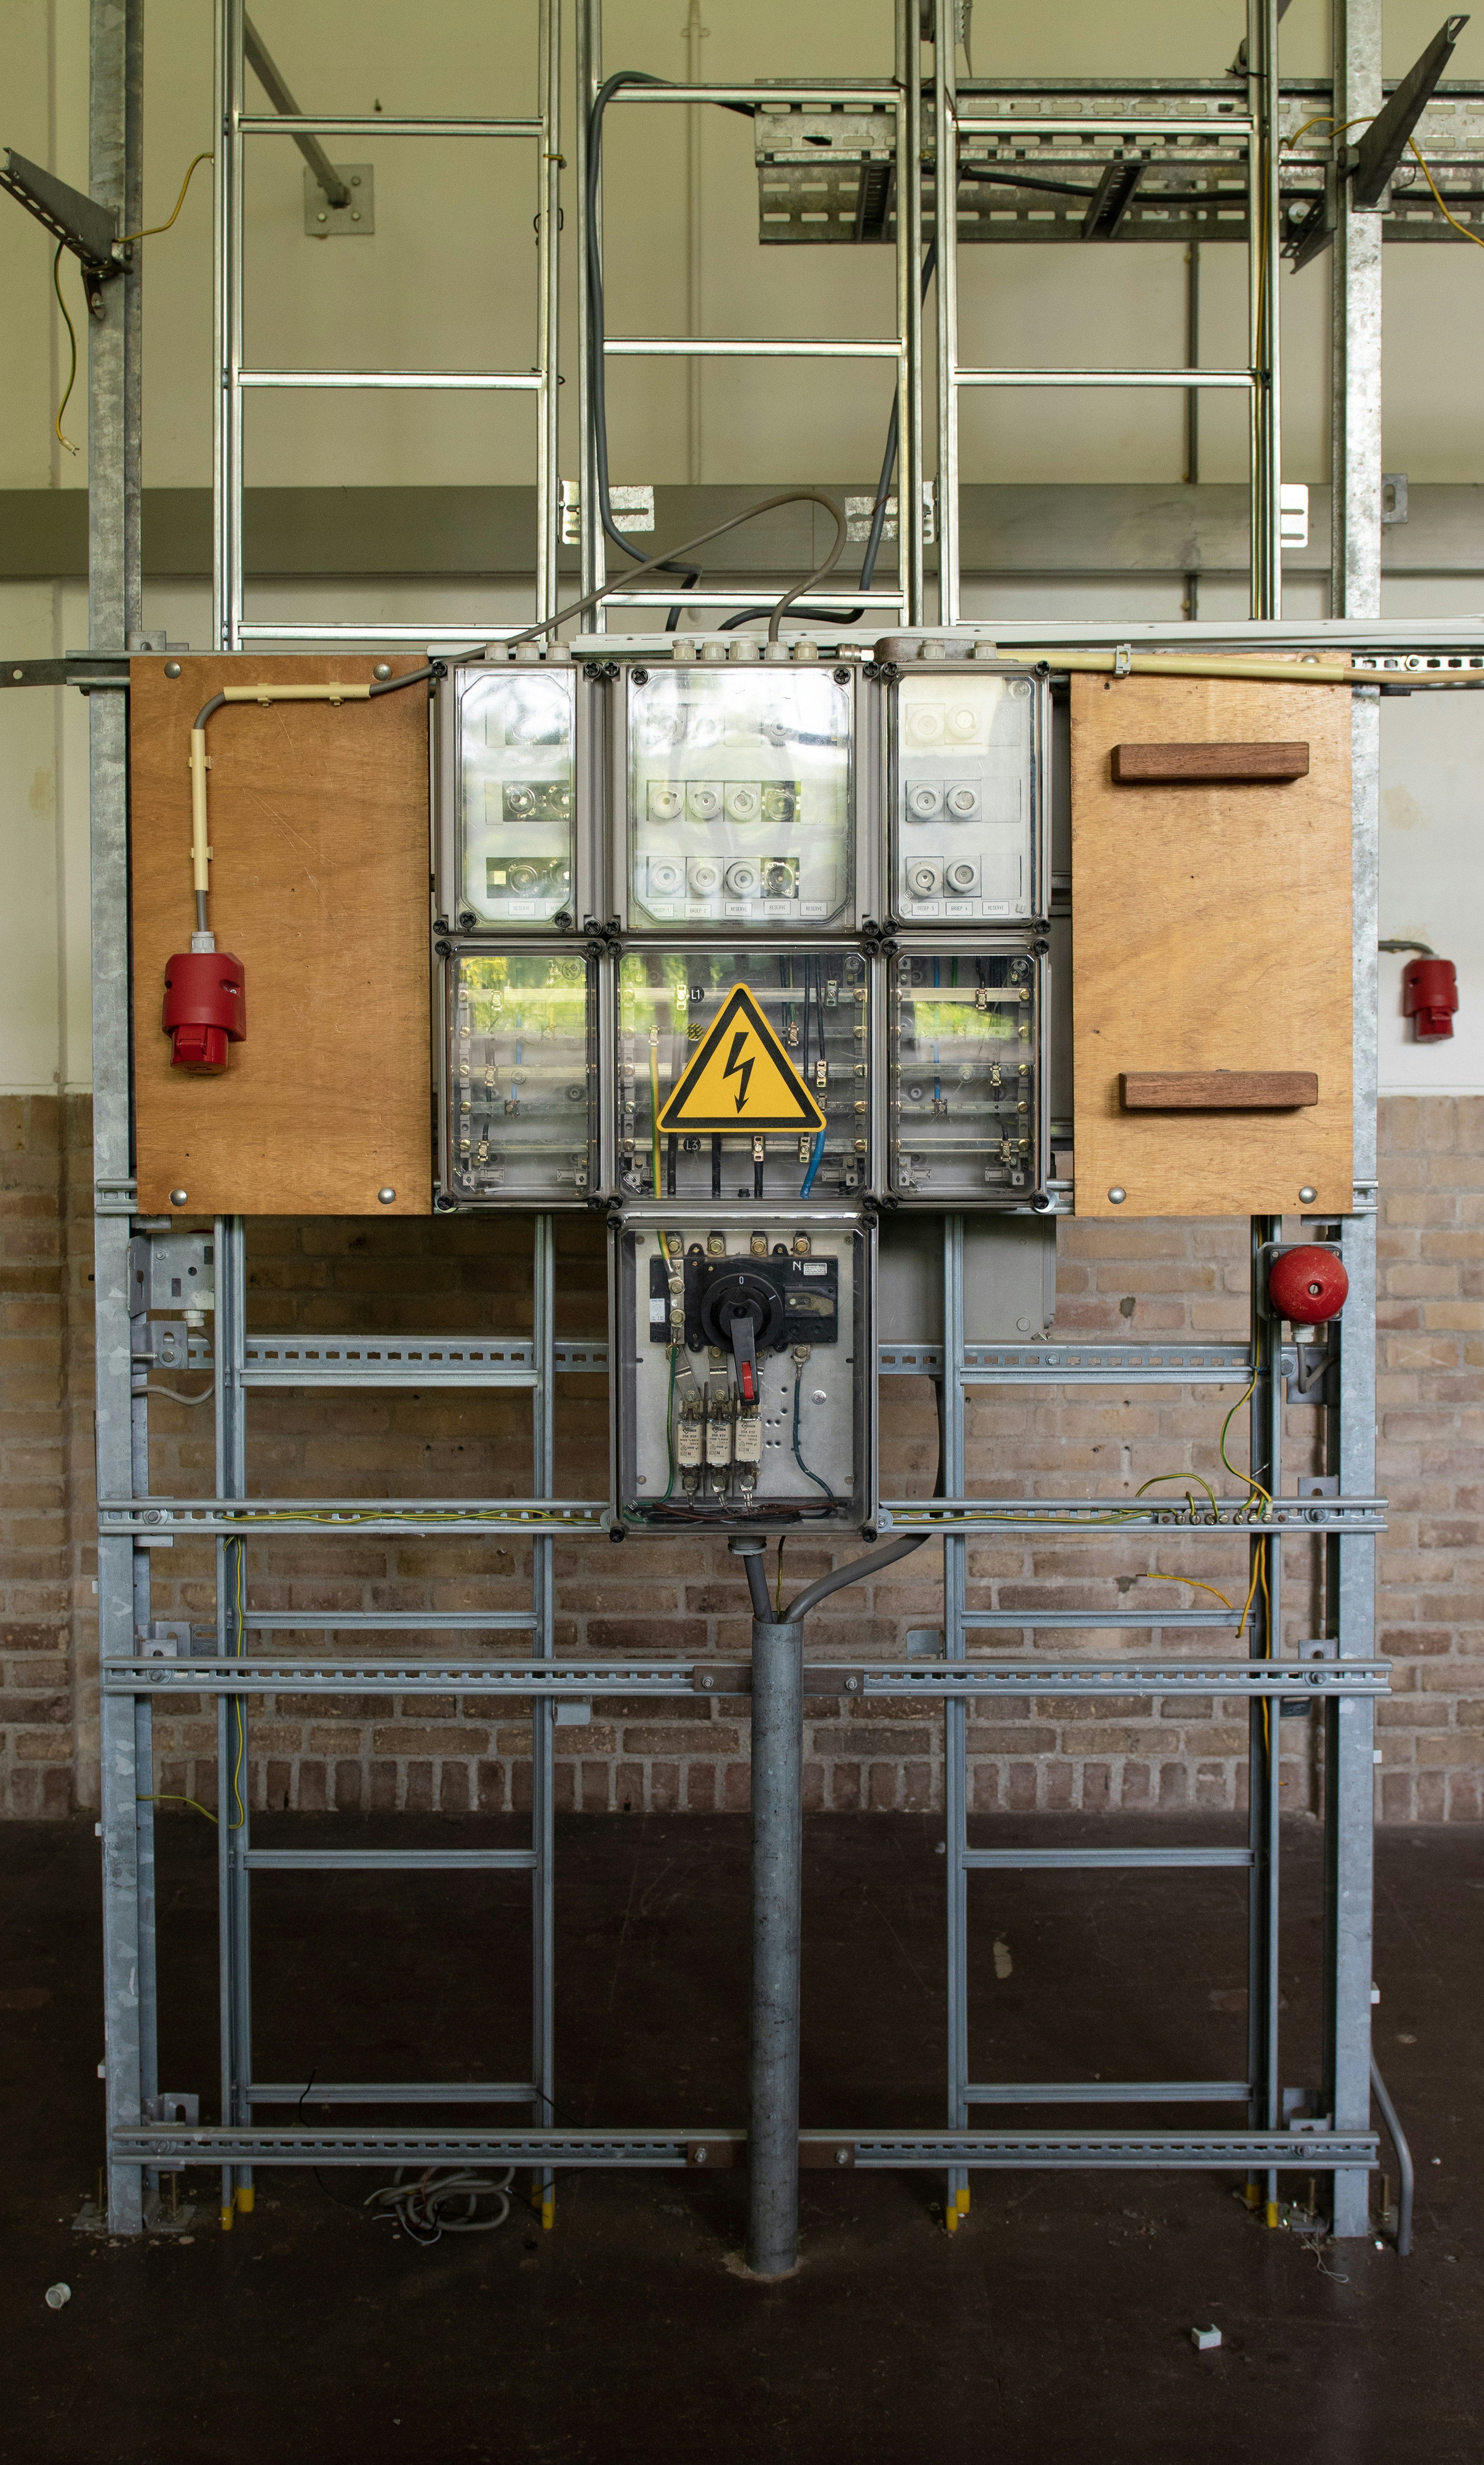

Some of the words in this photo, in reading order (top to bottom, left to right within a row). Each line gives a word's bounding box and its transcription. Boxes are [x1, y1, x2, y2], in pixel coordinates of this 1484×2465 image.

[691, 989, 700, 999] L1
[689, 1027, 700, 1037] PE
[687, 1140, 698, 1150] L3
[793, 1261, 802, 1271] N
